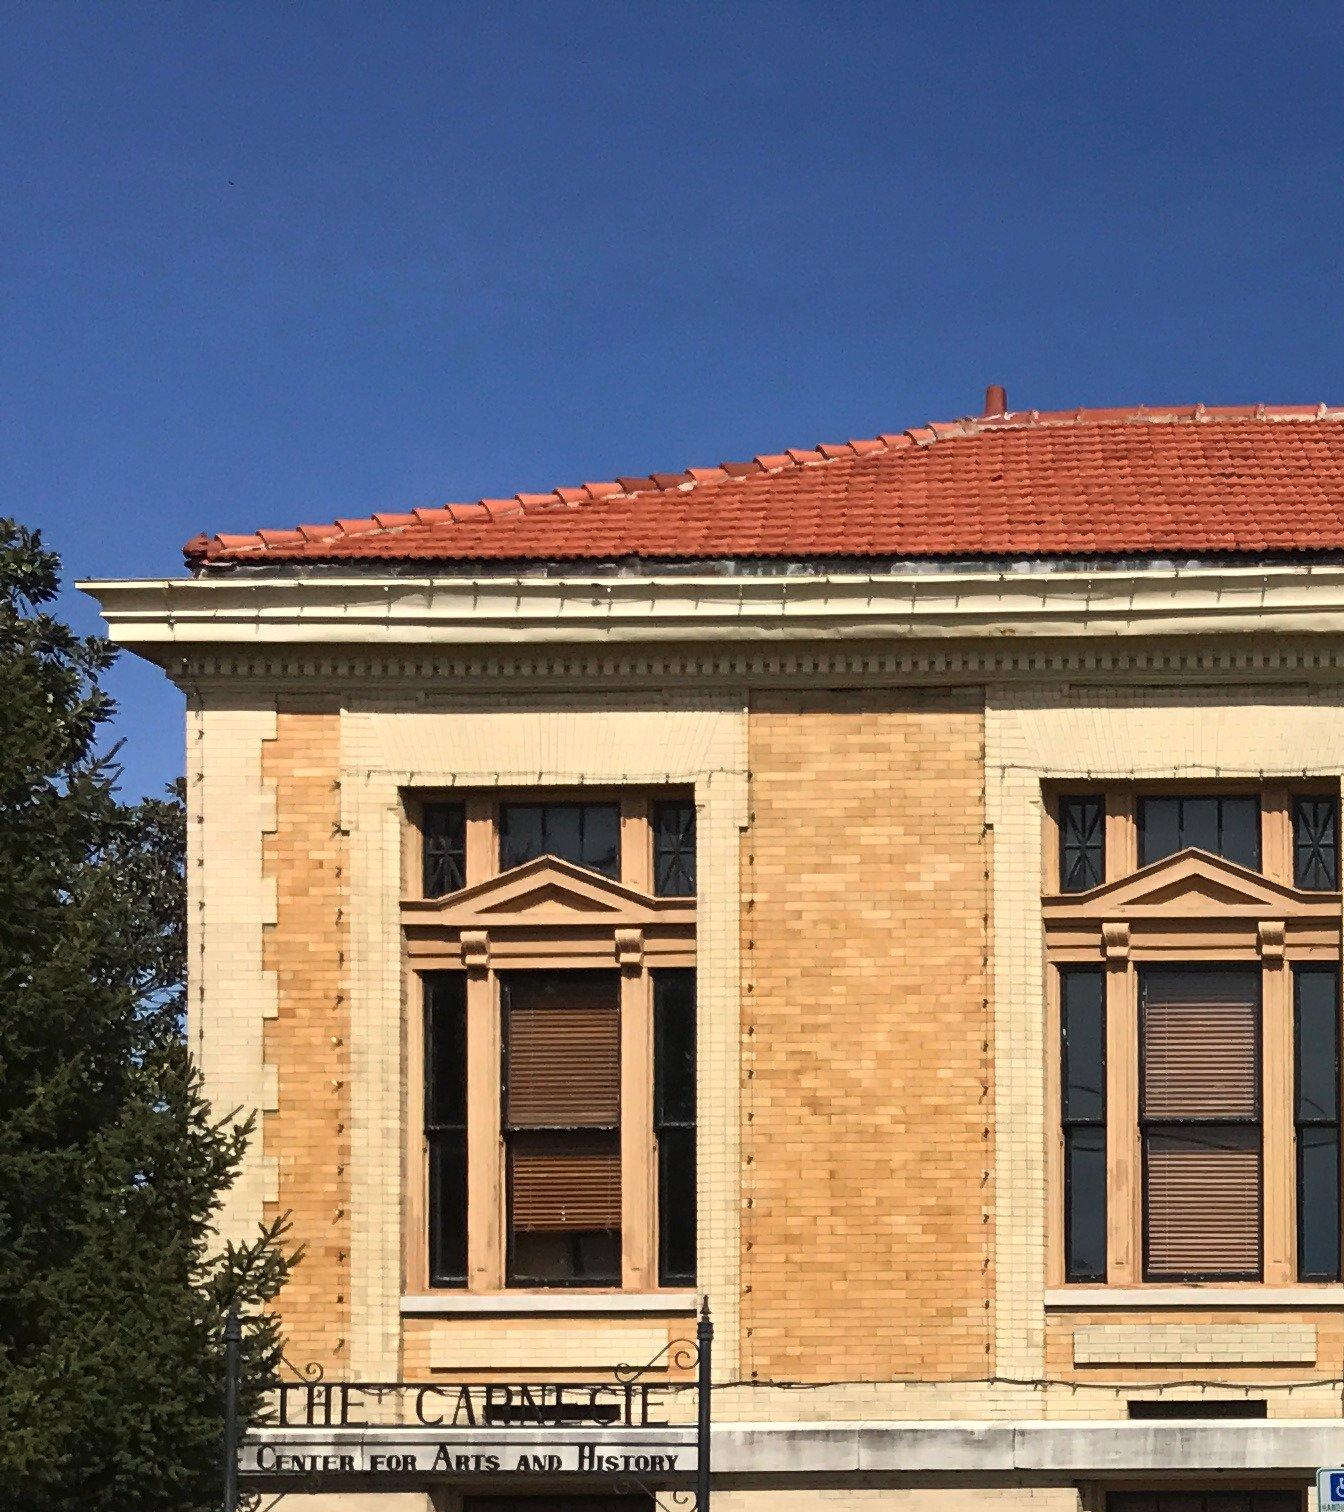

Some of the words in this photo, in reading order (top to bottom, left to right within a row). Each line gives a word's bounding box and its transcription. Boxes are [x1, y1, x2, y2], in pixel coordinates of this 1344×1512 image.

[273, 1384, 368, 1426] THE
[416, 1385, 669, 1426] CARNEGIE
[257, 1445, 355, 1471] CENTER
[370, 1454, 417, 1471] FOR
[431, 1444, 501, 1471] ARTS
[516, 1454, 561, 1471] AND
[576, 1444, 679, 1471] HISTORY
